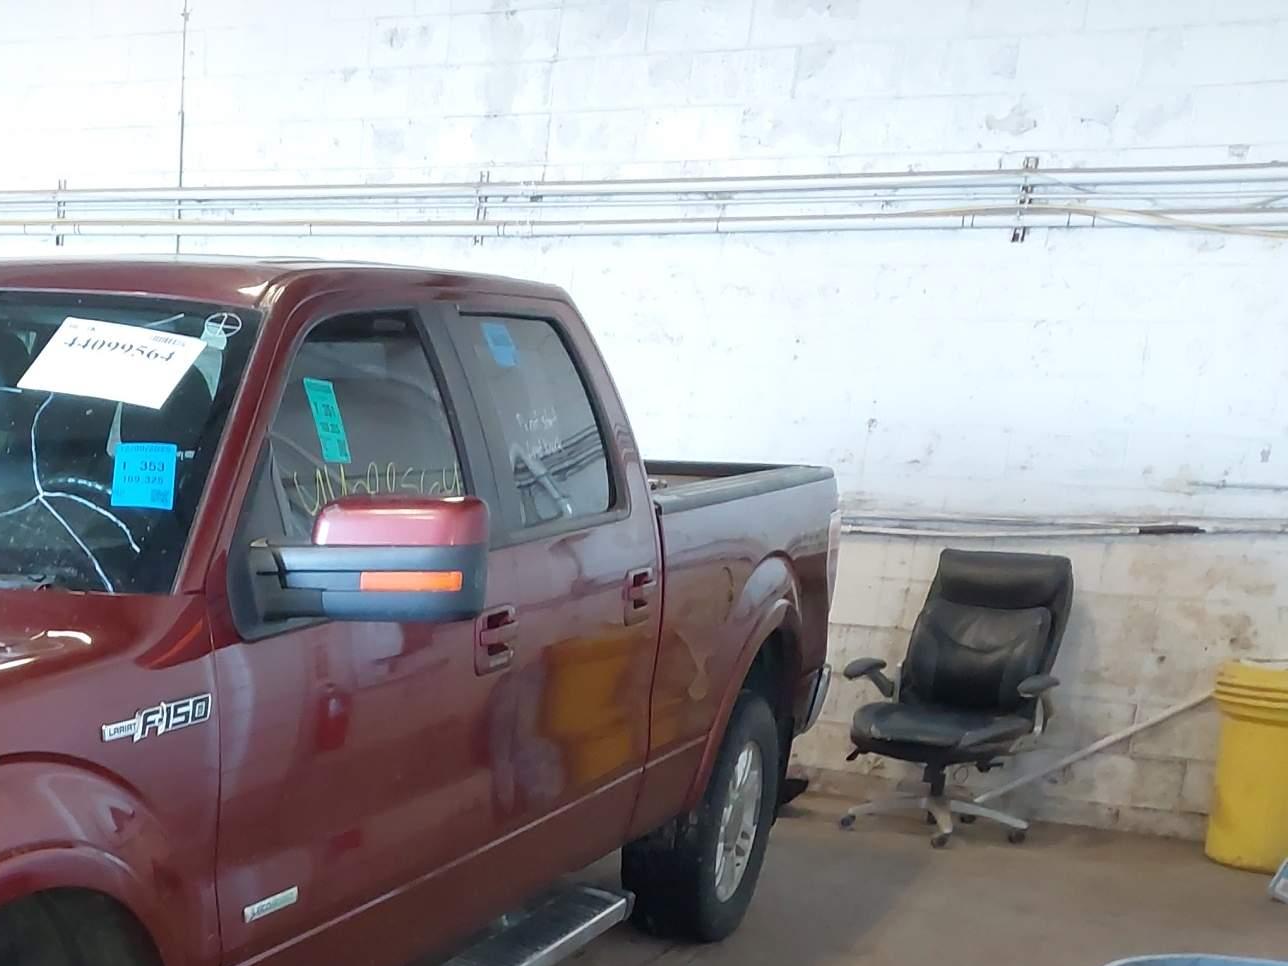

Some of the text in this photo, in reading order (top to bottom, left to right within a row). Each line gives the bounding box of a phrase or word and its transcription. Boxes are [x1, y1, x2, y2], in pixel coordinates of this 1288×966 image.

[63, 335, 176, 363] 44099564
[139, 461, 165, 472] 353
[108, 721, 138, 737] LARIAT
